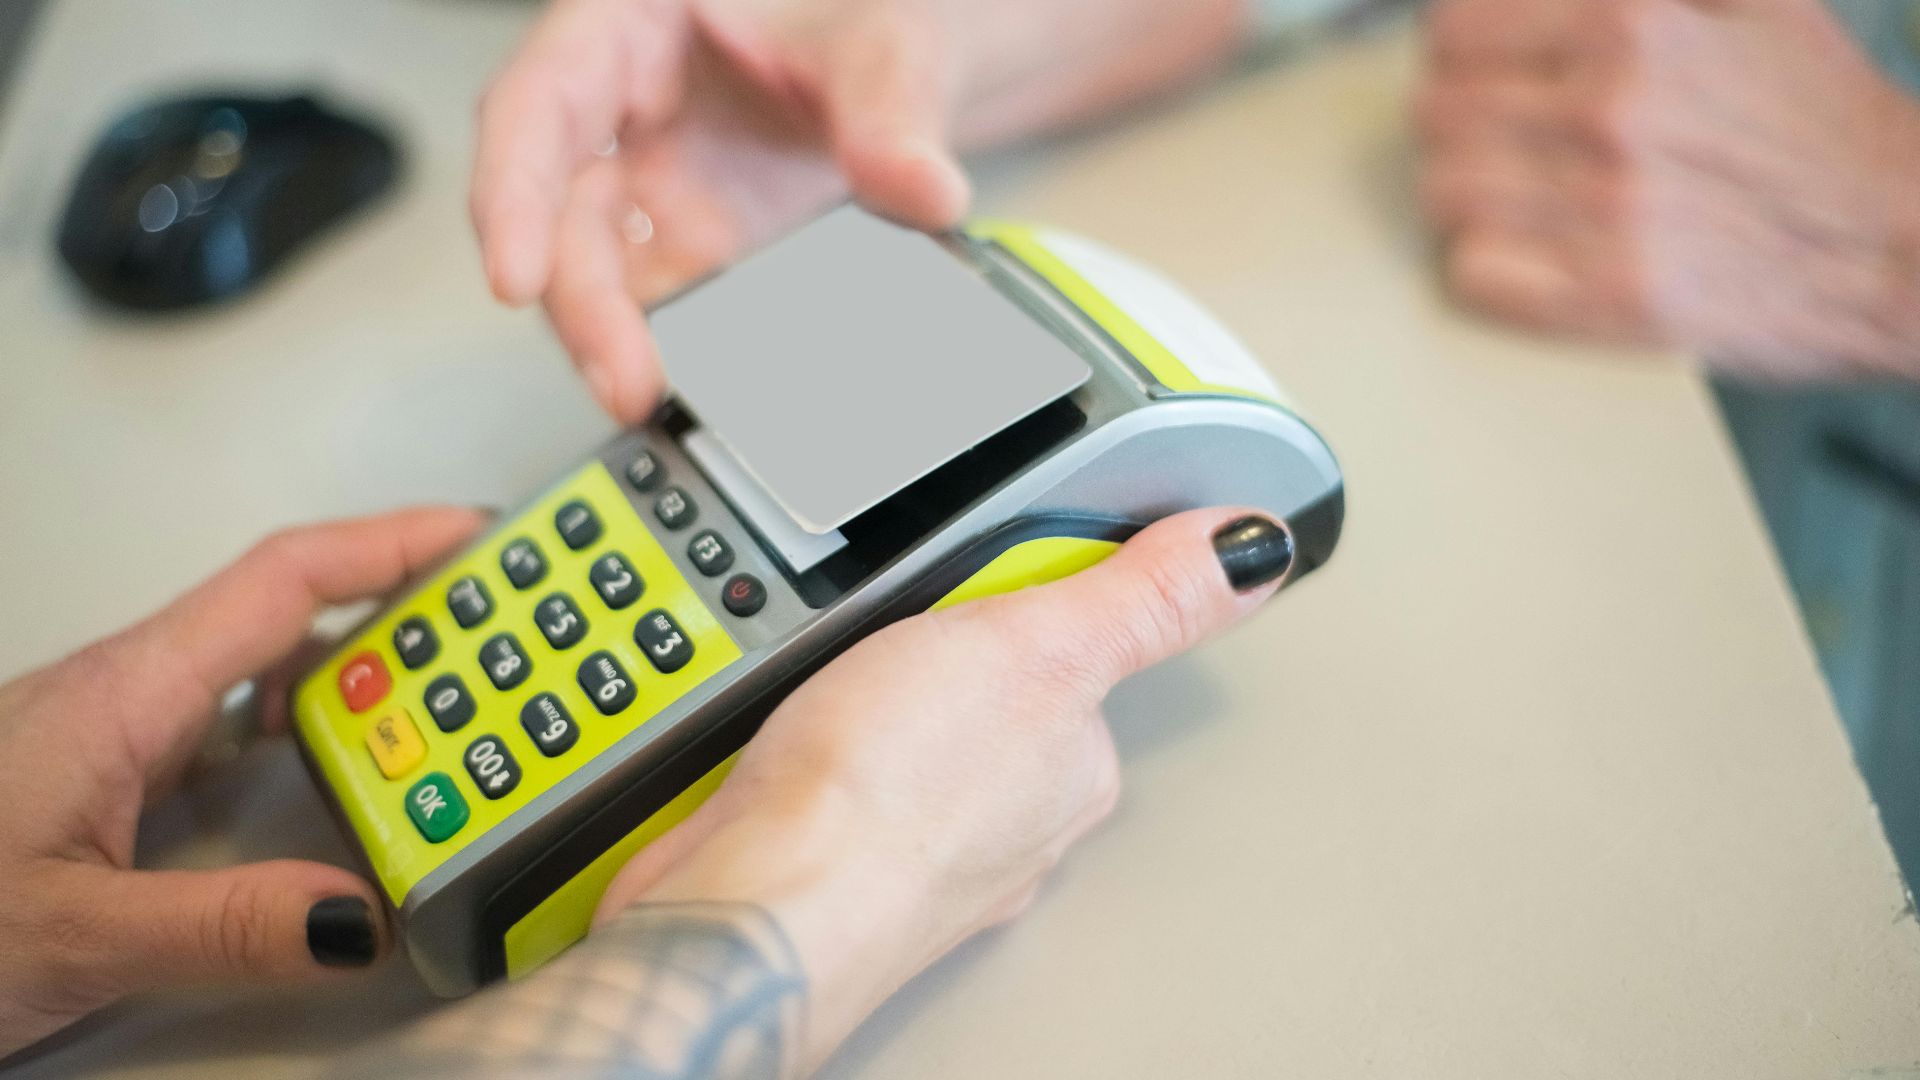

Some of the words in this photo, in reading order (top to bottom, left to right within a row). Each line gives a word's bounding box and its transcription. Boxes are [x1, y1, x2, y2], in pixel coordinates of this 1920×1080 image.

[660, 491, 686, 519] F2
[695, 535, 722, 561] F3
[605, 572, 632, 597] 2
[550, 613, 577, 636] 5
[654, 614, 671, 631] DEF
[655, 631, 683, 656] 3
[496, 654, 522, 678] 8
[598, 658, 617, 679] MNO
[600, 678, 627, 700] 6
[539, 697, 561, 721] WXYZ
[541, 720, 568, 745] 9
[471, 740, 504, 776] 00
[415, 784, 447, 820] OK
